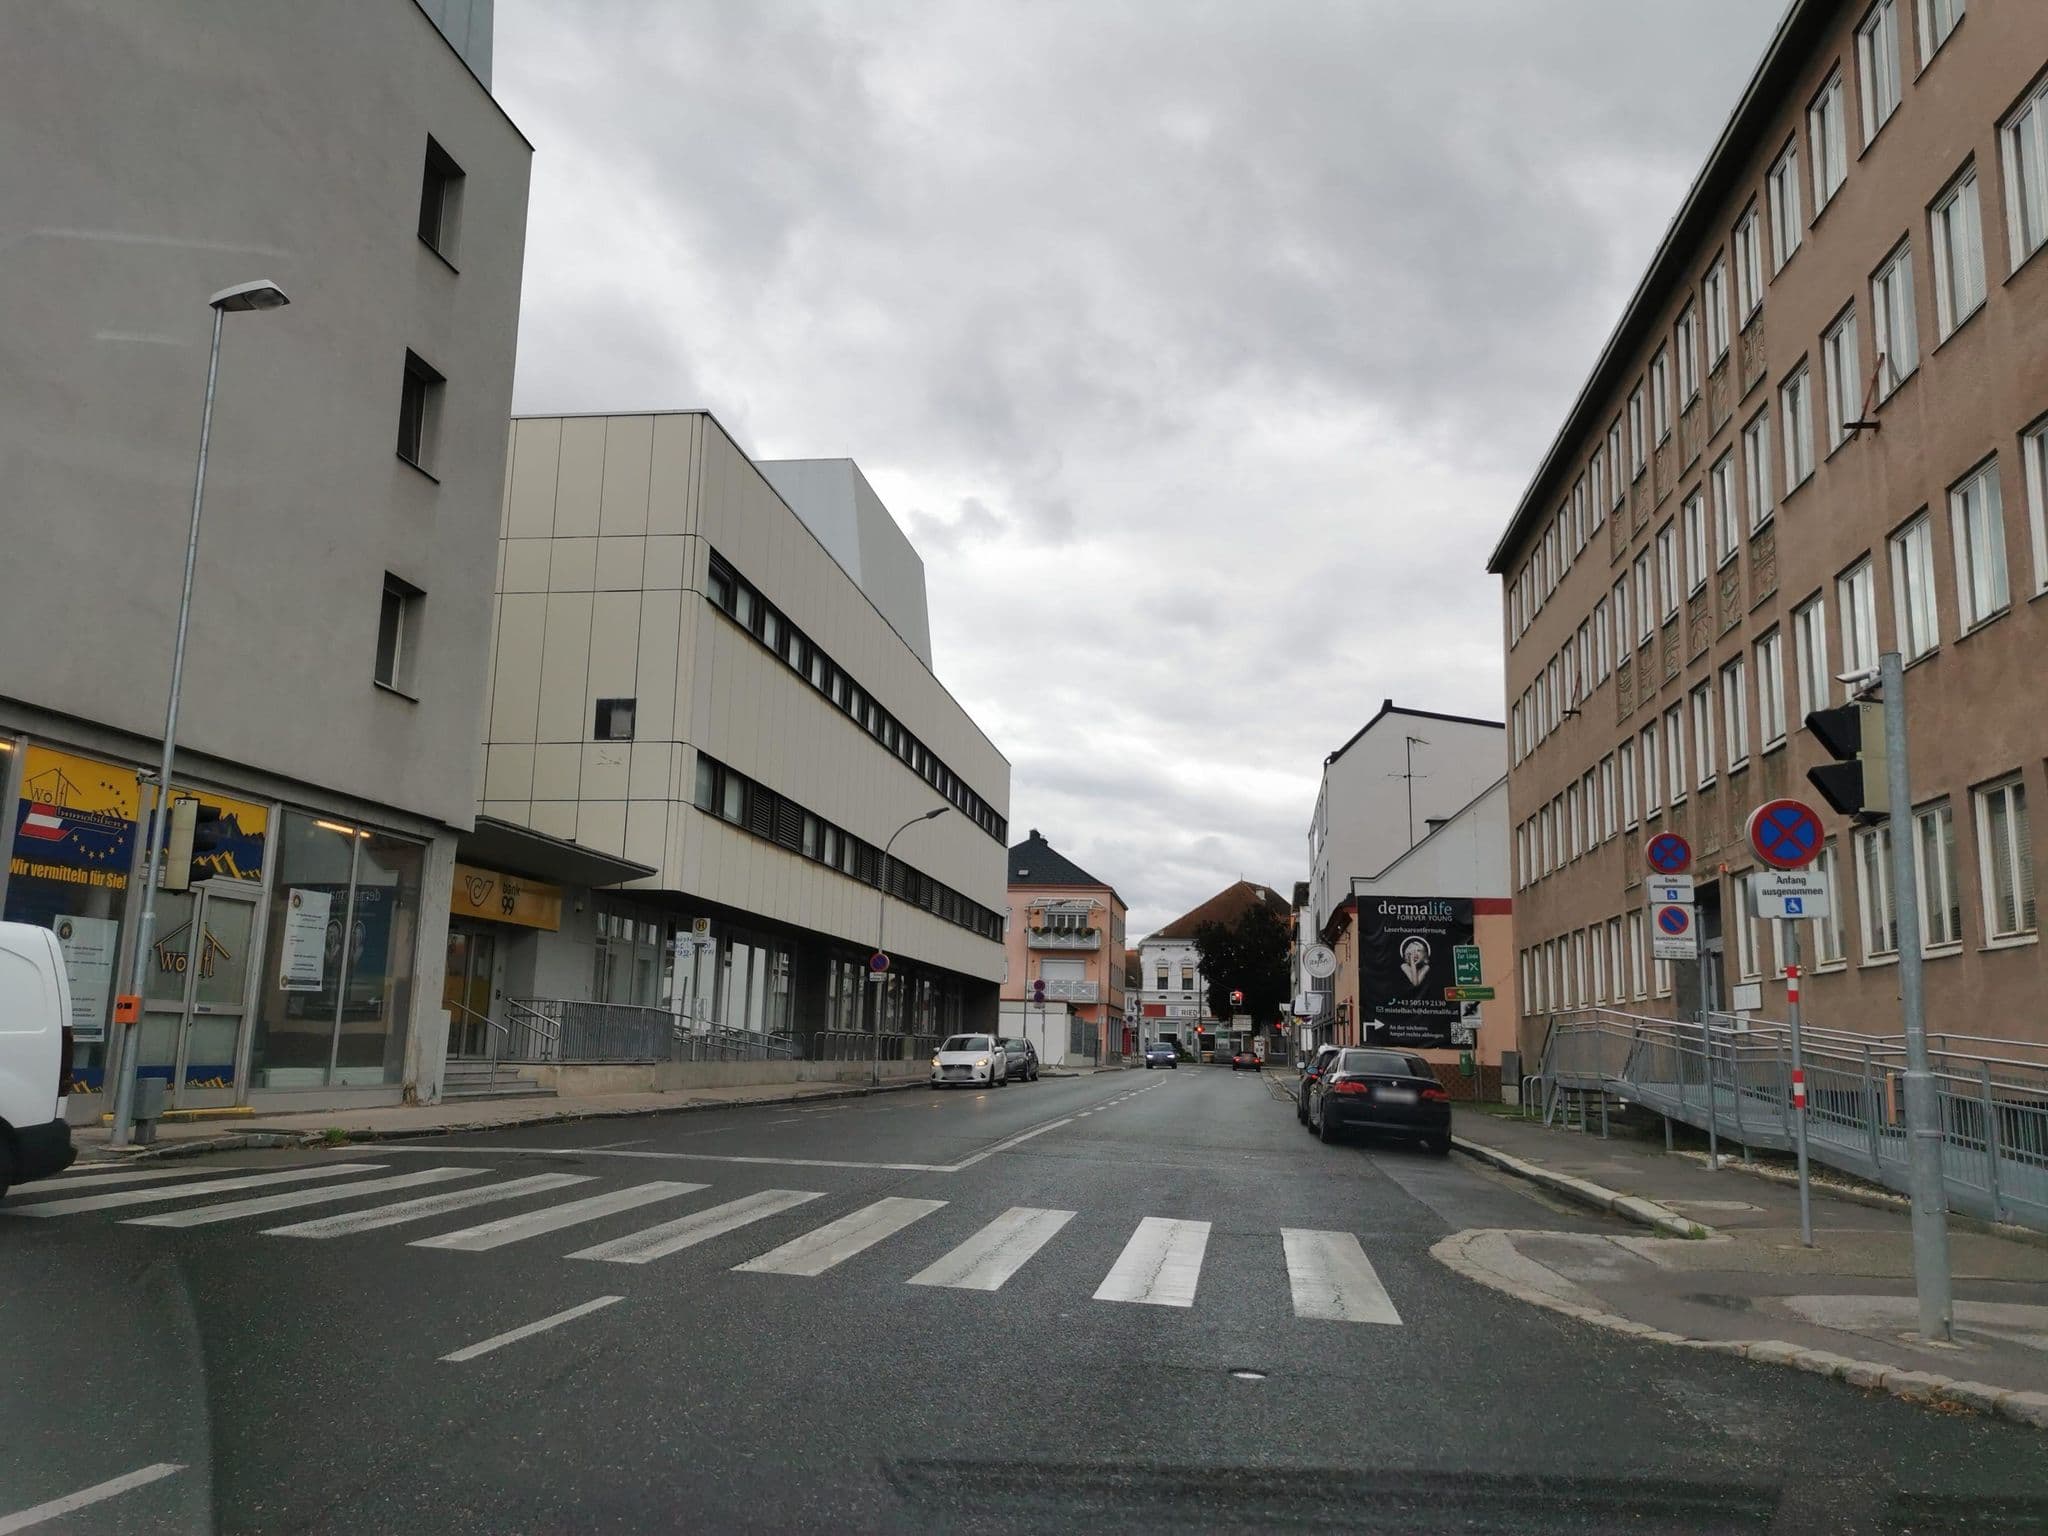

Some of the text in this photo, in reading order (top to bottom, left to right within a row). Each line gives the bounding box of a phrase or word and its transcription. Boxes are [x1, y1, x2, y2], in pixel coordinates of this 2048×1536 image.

[9, 858, 128, 890] Wir vermitteln für Sie!
[1776, 875, 1807, 886] Anfang
[1762, 888, 1824, 897] ausgenommen
[502, 896, 515, 916] 99
[1378, 900, 1453, 916] dermalife
